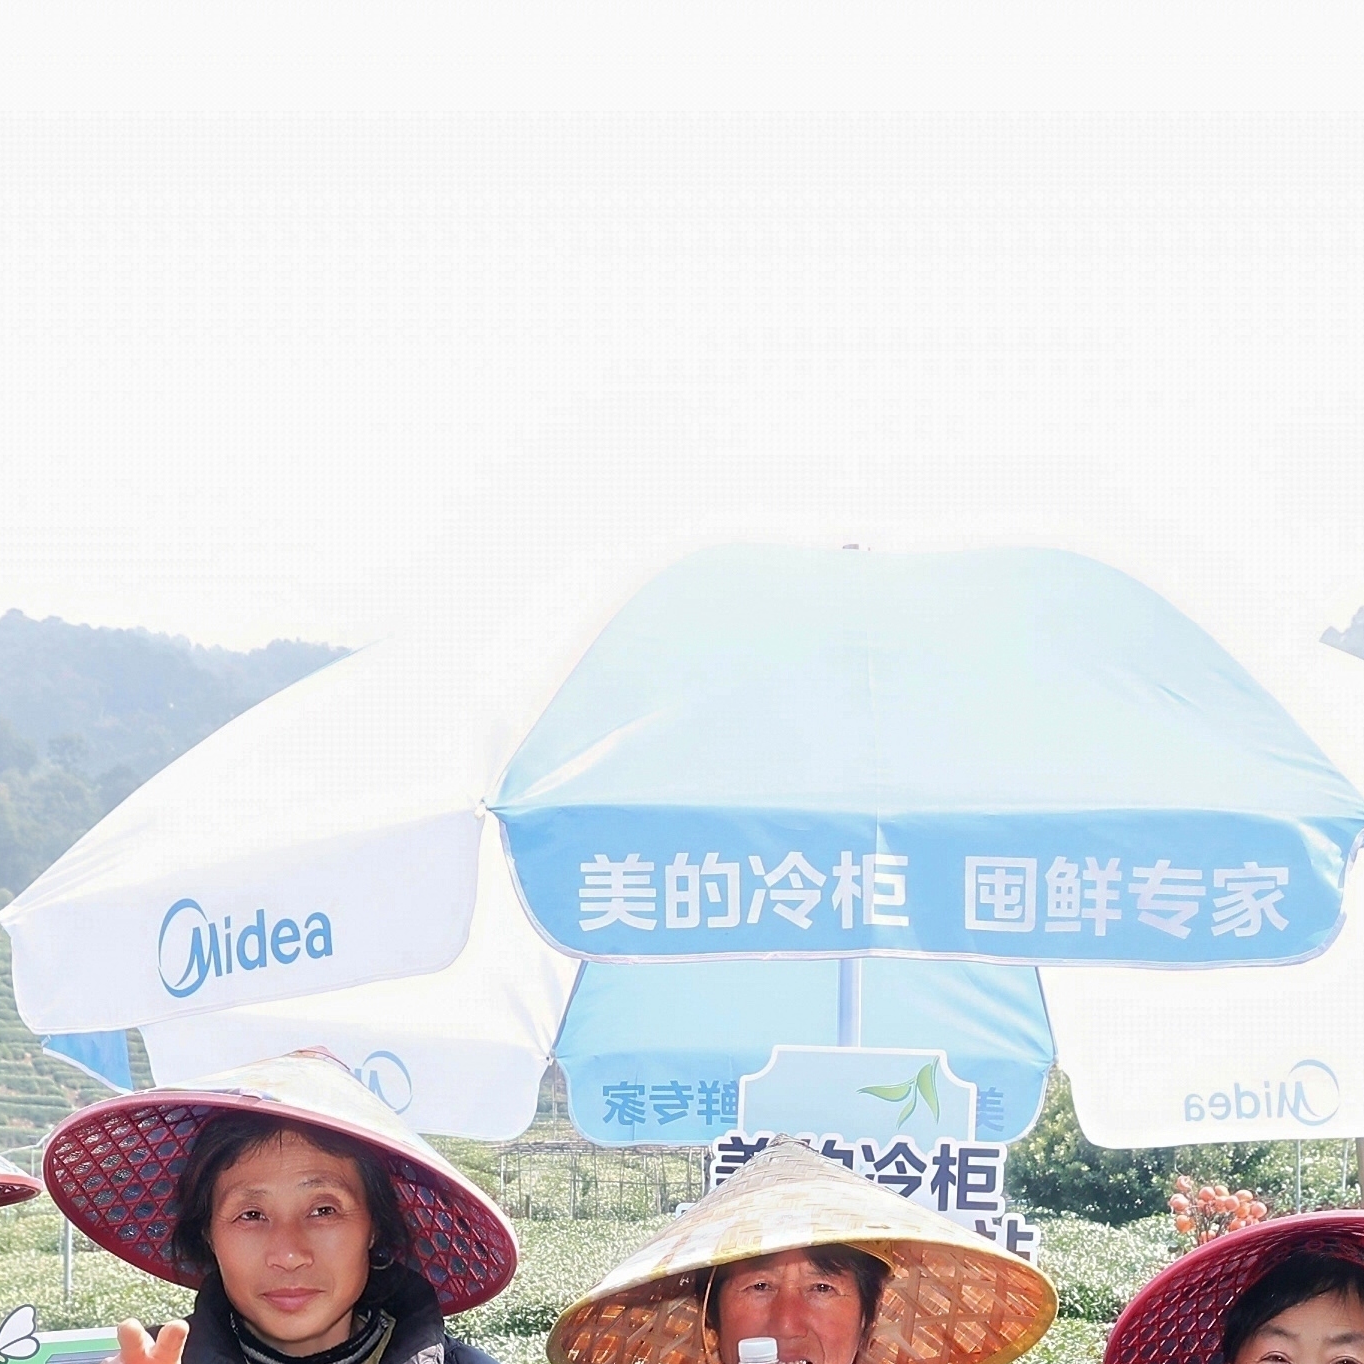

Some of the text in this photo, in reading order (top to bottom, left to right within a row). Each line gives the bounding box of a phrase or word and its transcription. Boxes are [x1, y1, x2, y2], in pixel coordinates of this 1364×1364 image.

[578, 851, 1292, 940] 美的冷柜 囤鲜专家
[158, 898, 334, 998] Midea
